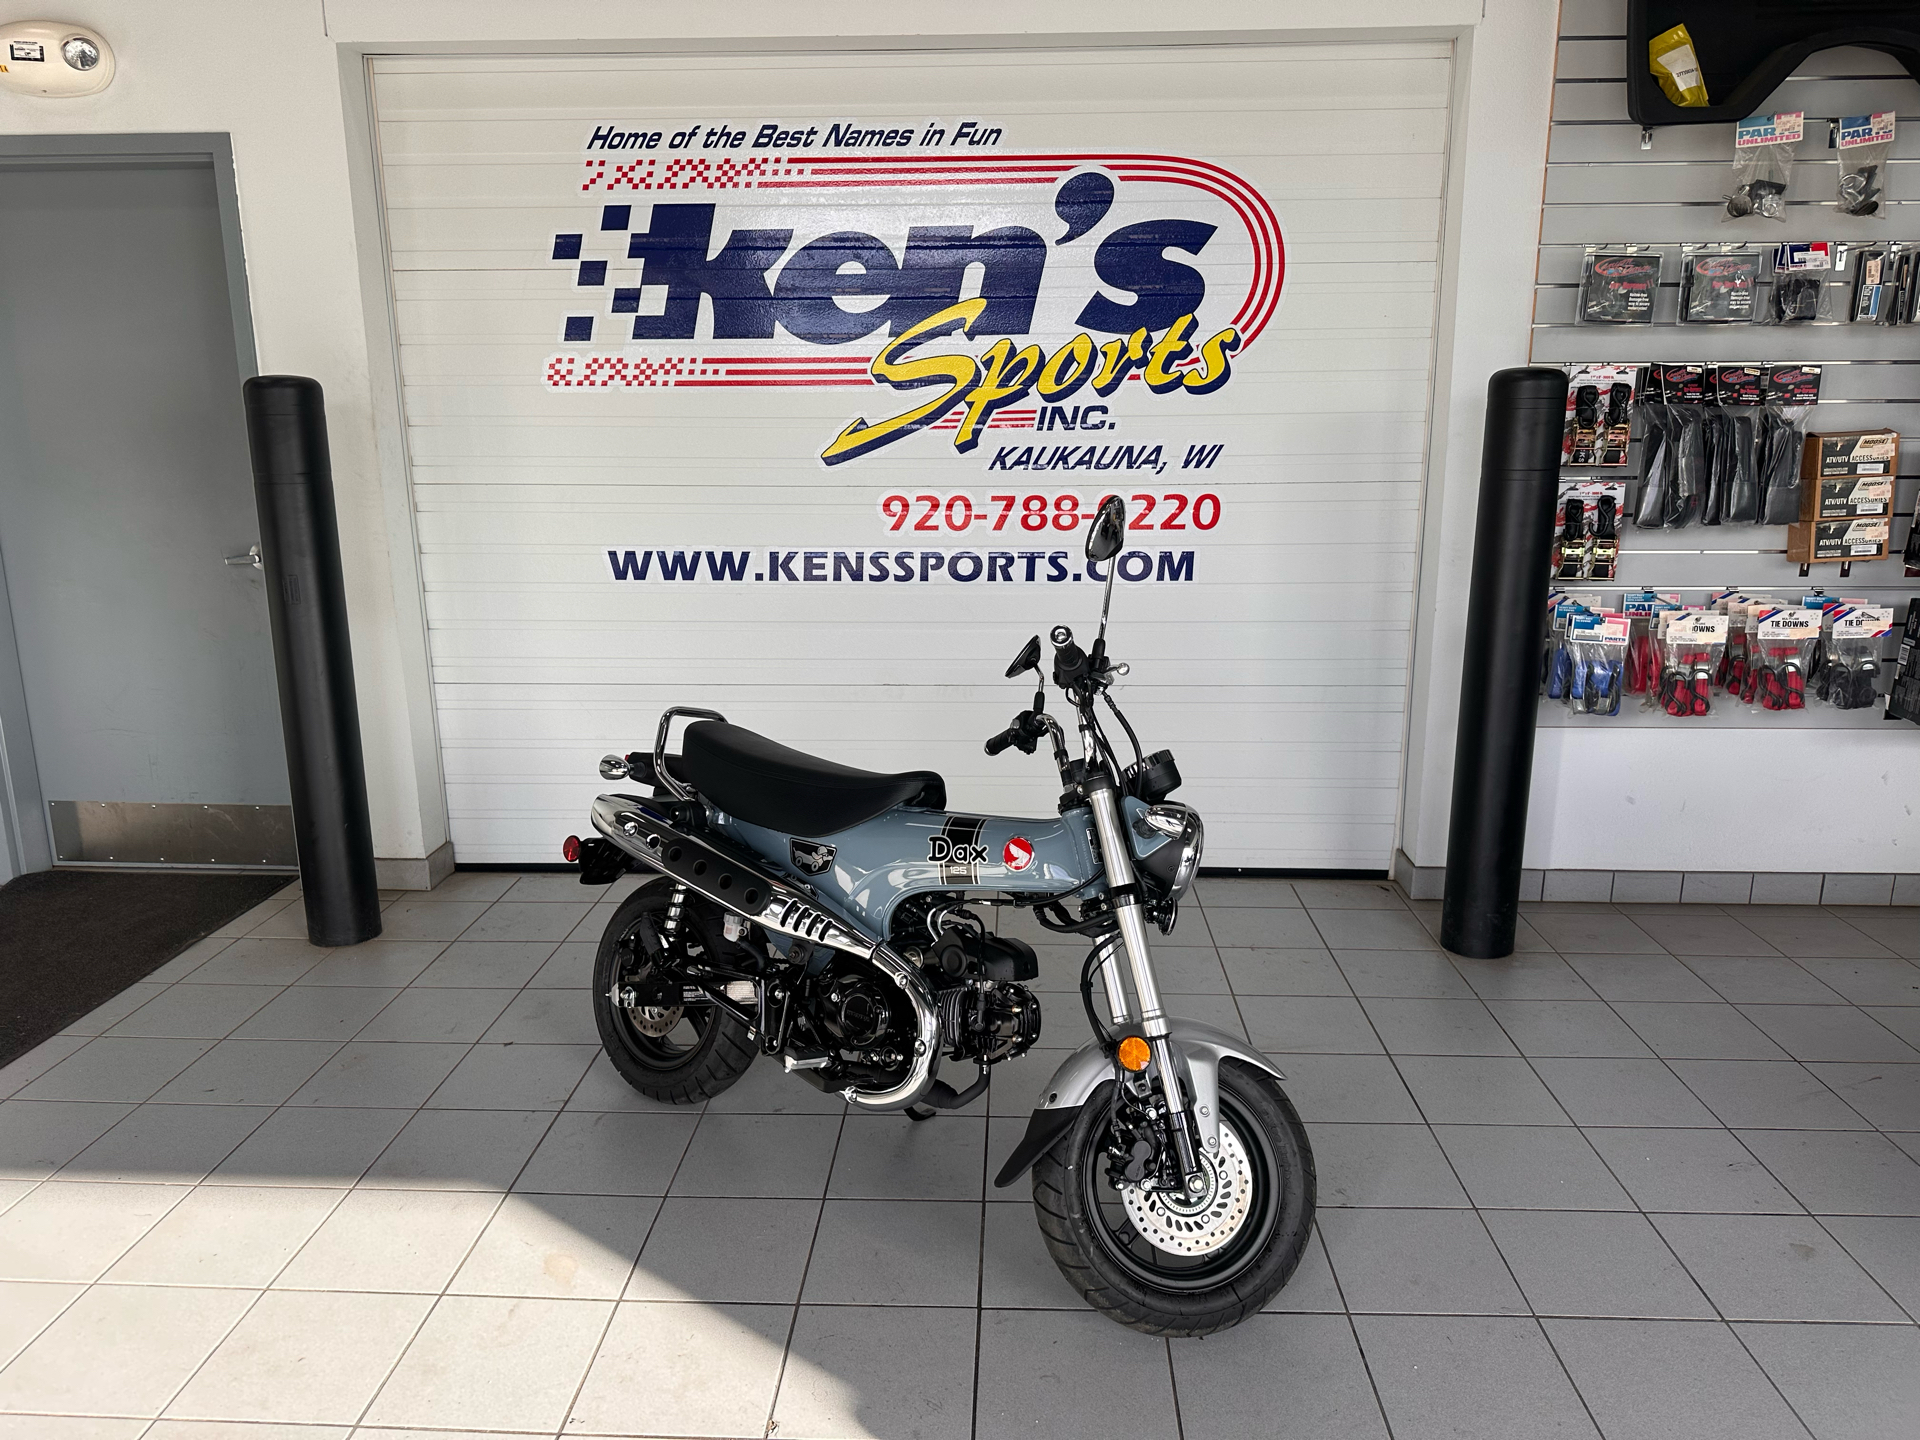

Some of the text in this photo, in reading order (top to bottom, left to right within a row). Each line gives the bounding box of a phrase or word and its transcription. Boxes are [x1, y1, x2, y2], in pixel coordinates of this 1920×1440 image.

[586, 121, 1003, 150] Home of the Best Names in Fun
[1738, 127, 1800, 139] PAR
[1738, 133, 1801, 146] UNLIMITED
[1841, 128, 1893, 140] PAR
[1841, 133, 1893, 147] UNLIMITED
[820, 298, 1241, 466] Sports
[1037, 405, 1116, 432] INC.
[988, 444, 1225, 475] KAUKAUNA, WI
[881, 493, 1221, 532] 920-788-220
[1819, 538, 1842, 546] ATV/UTV
[608, 550, 1195, 583] WWW.KENSSPORTS.COM
[1692, 625, 1715, 633] OWNS
[1782, 620, 1809, 628] DOWNS
[927, 835, 988, 864] Dax
[949, 866, 967, 875] 125
